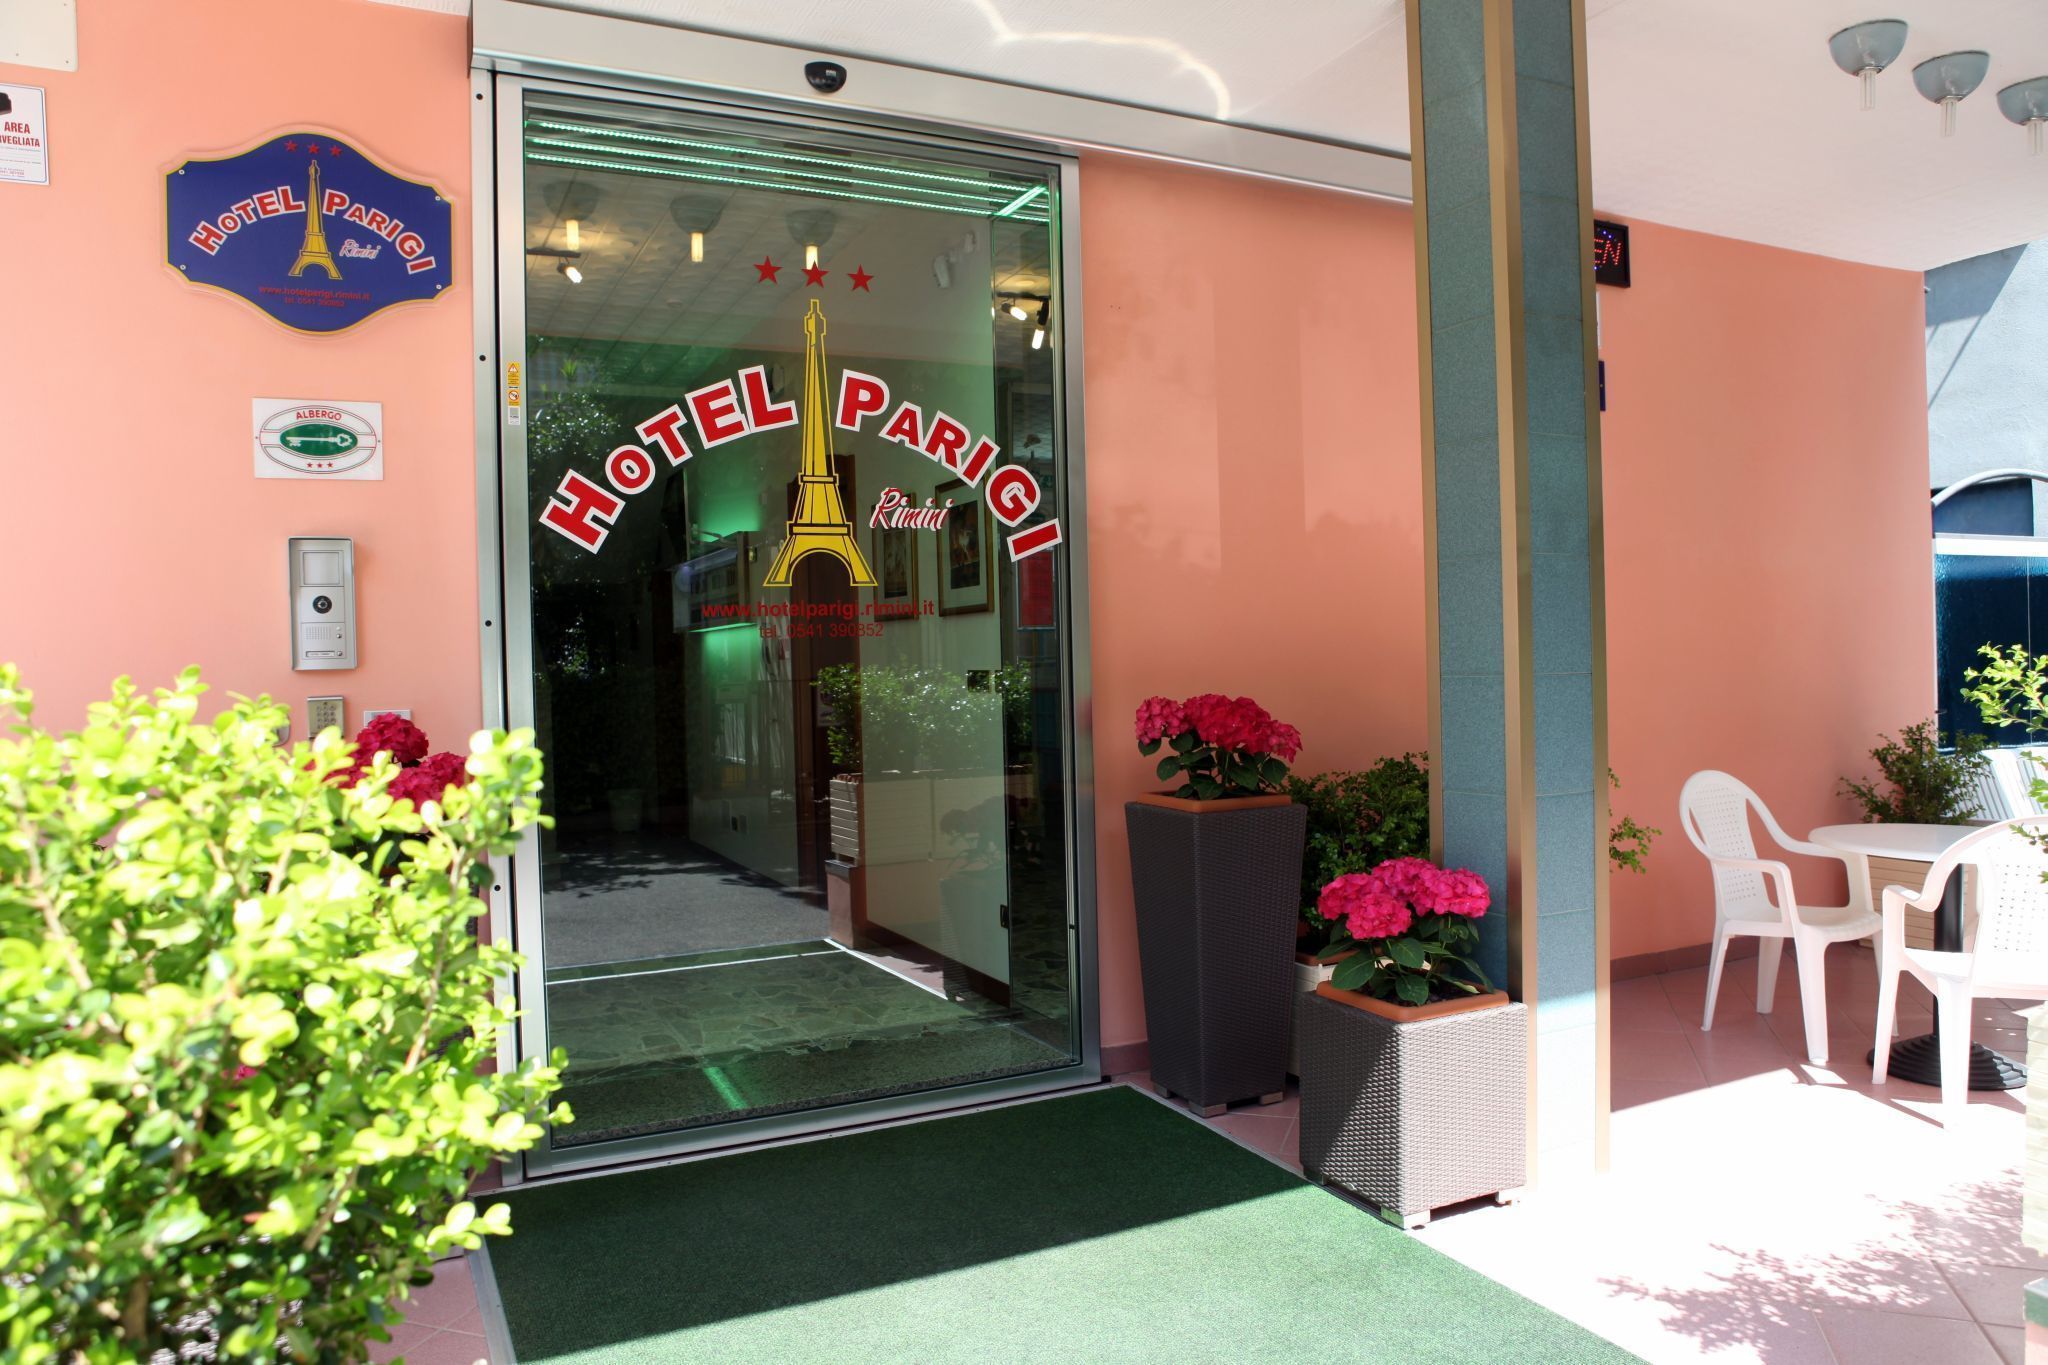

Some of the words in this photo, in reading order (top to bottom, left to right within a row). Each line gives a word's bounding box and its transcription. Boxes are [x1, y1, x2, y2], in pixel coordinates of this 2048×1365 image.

[4, 121, 31, 134] AREA
[188, 185, 305, 256] HOTEL
[322, 188, 436, 275] PARIGI
[339, 239, 381, 259] Rimini
[296, 409, 342, 421] ALBERGO
[539, 364, 799, 555] HOTEL
[836, 368, 1062, 562] PARIGI
[869, 487, 955, 531] Rimini
[702, 600, 934, 621] www.hotelparigi.rimini.it
[786, 623, 823, 639] 0541
